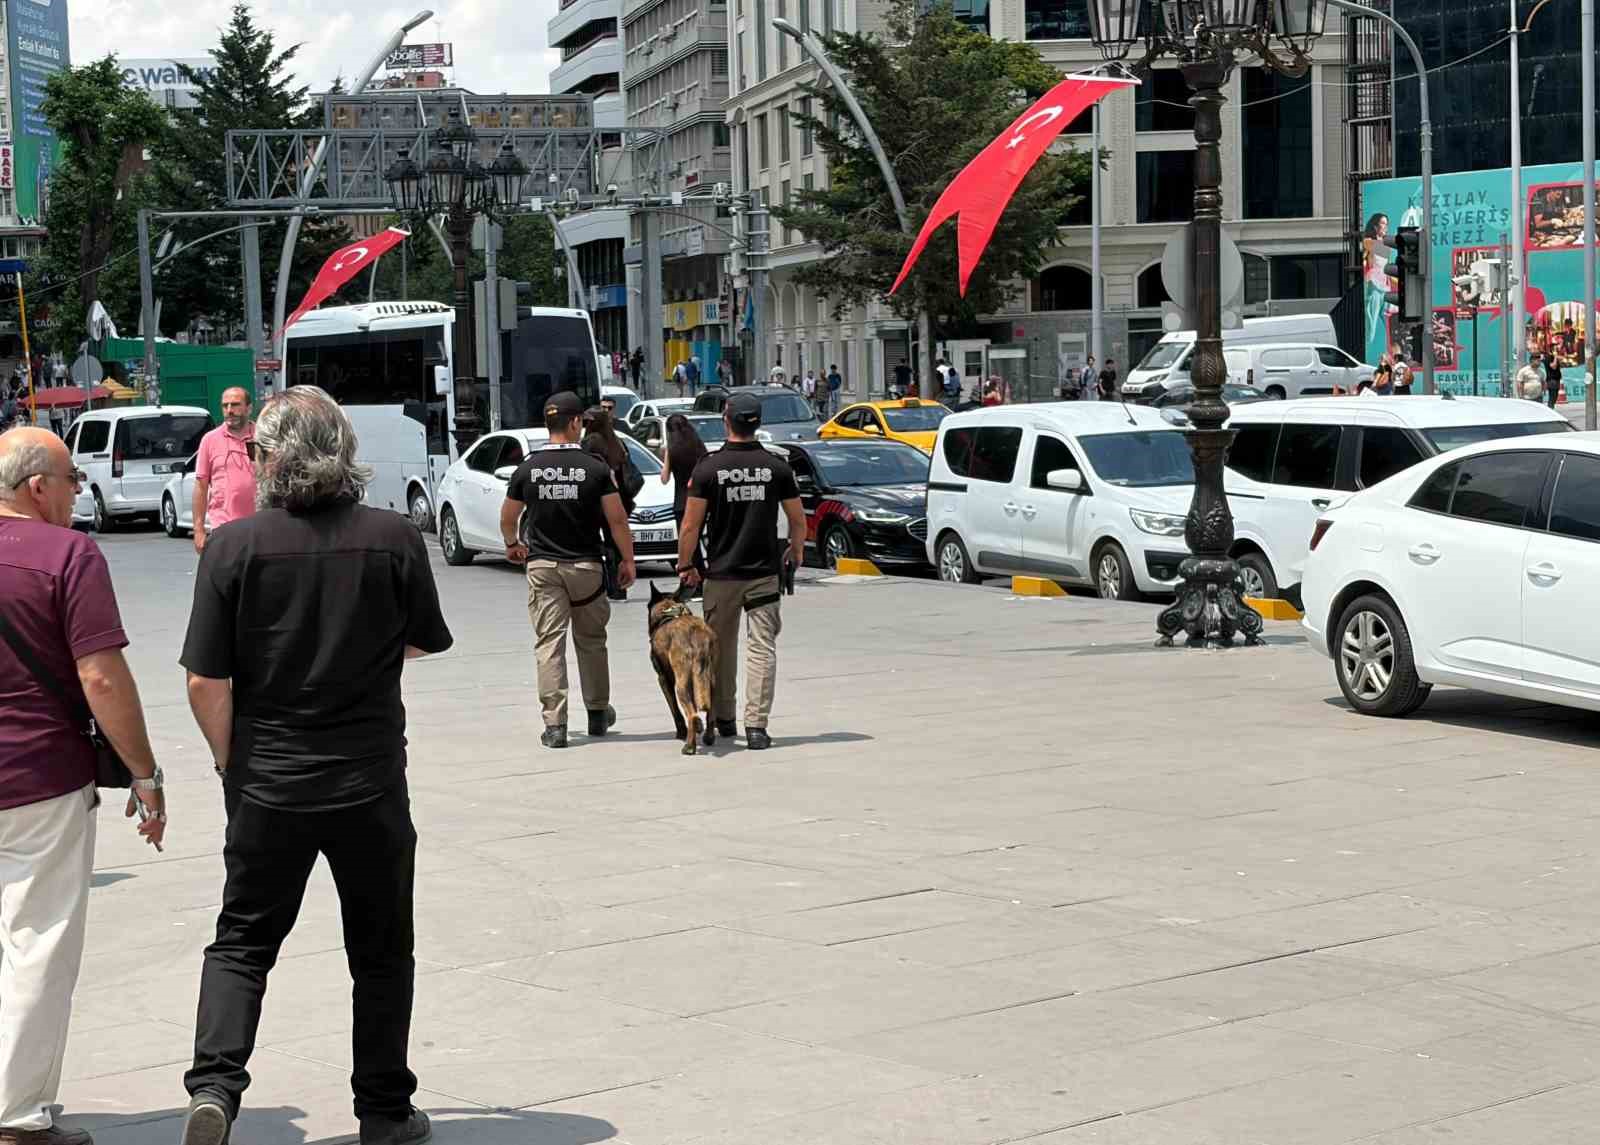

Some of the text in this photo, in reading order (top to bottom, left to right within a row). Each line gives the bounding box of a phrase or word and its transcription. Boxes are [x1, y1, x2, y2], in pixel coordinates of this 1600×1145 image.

[1407, 189, 1488, 210] KZILAY
[1407, 205, 1510, 230] AIŞVERİŞ
[538, 484, 579, 500] KEM
[726, 484, 766, 502] KEM
